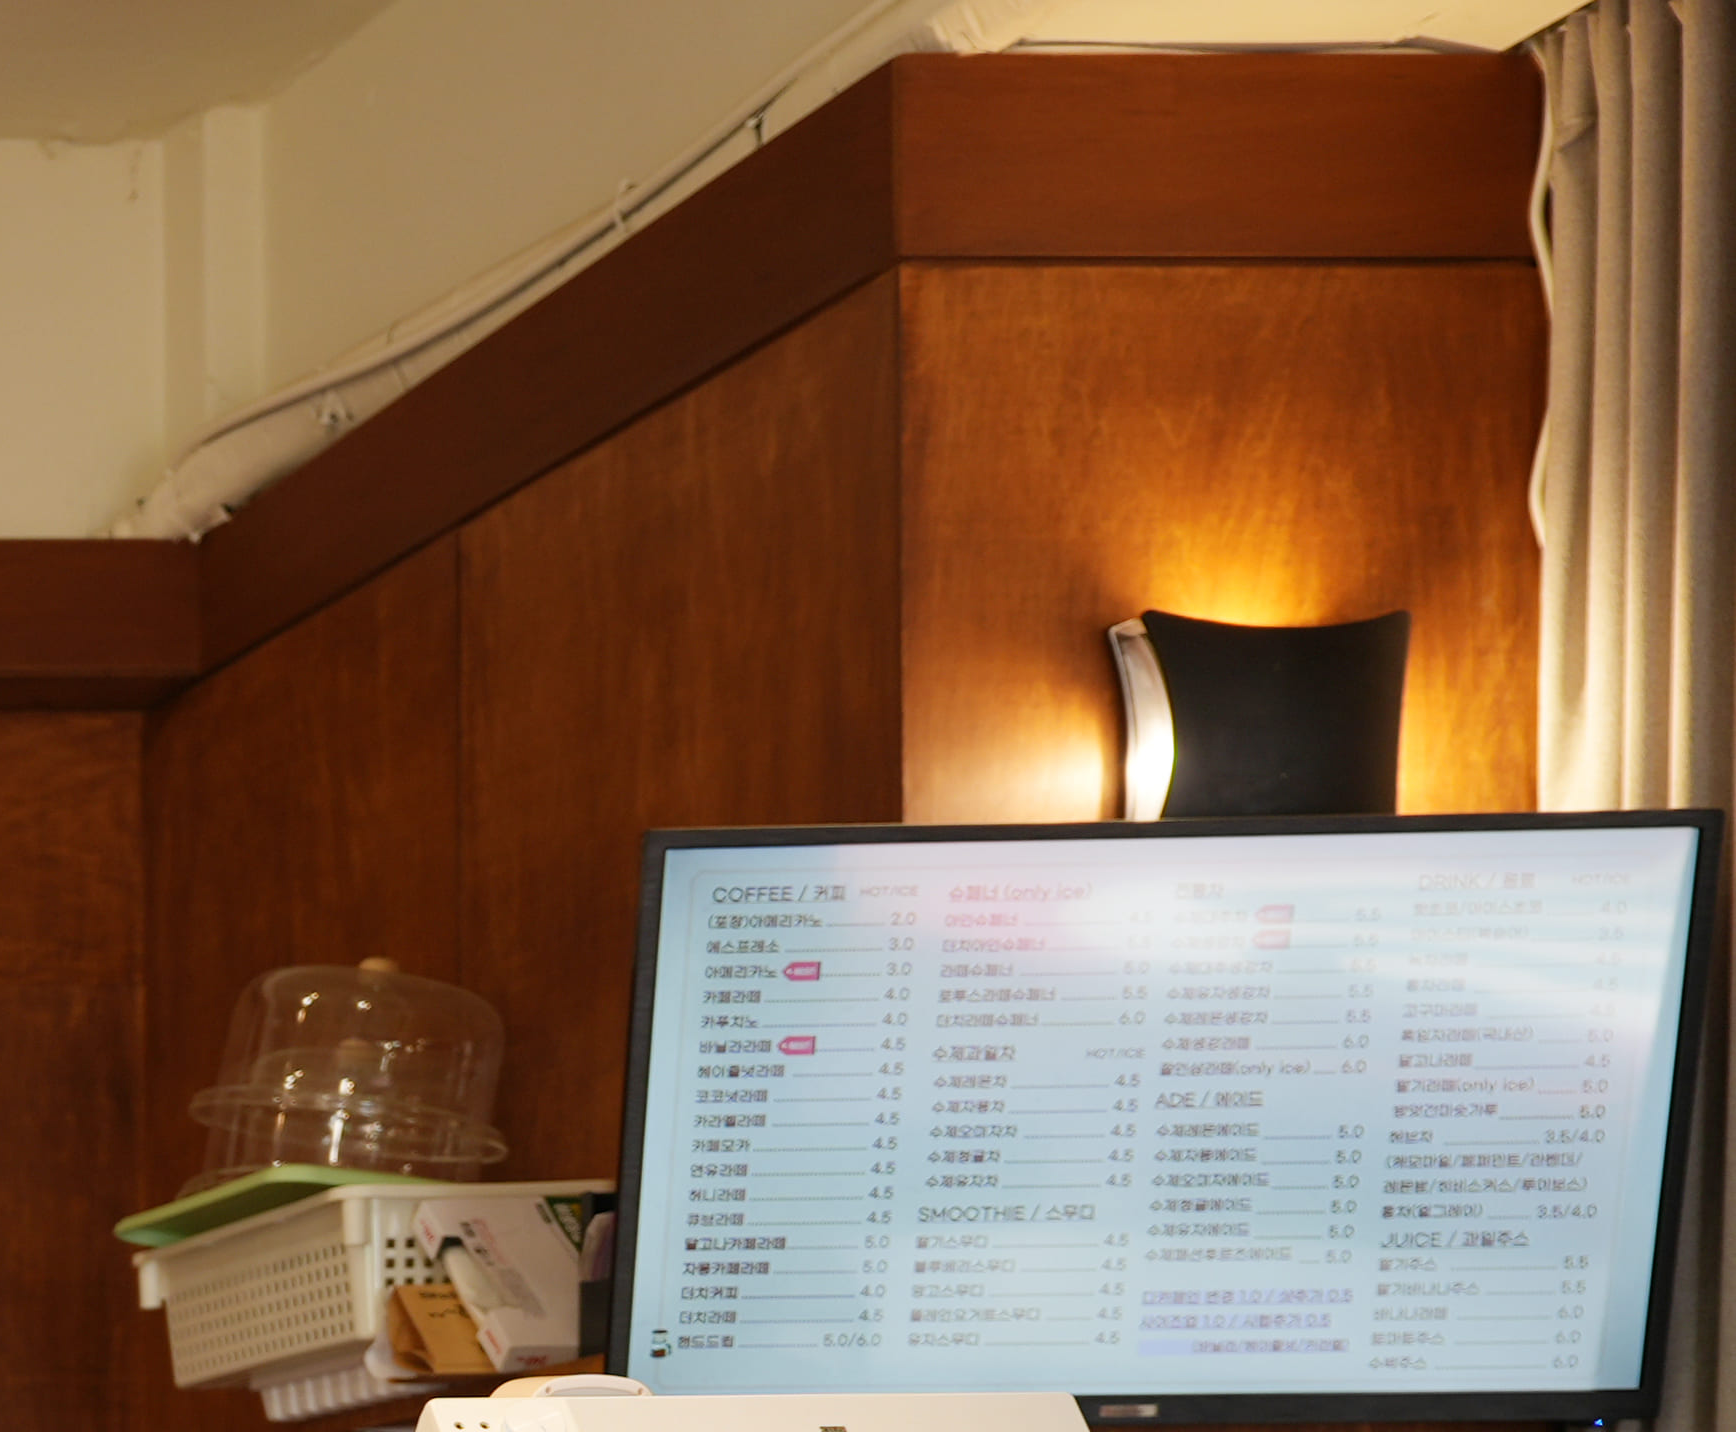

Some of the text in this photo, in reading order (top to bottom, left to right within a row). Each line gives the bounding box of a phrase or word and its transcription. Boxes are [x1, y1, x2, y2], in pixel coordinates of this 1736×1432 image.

[712, 885, 794, 904] COFFEE
[918, 1205, 1027, 1223] SMOOTHIE
[1381, 1231, 1442, 1249] JUICE
